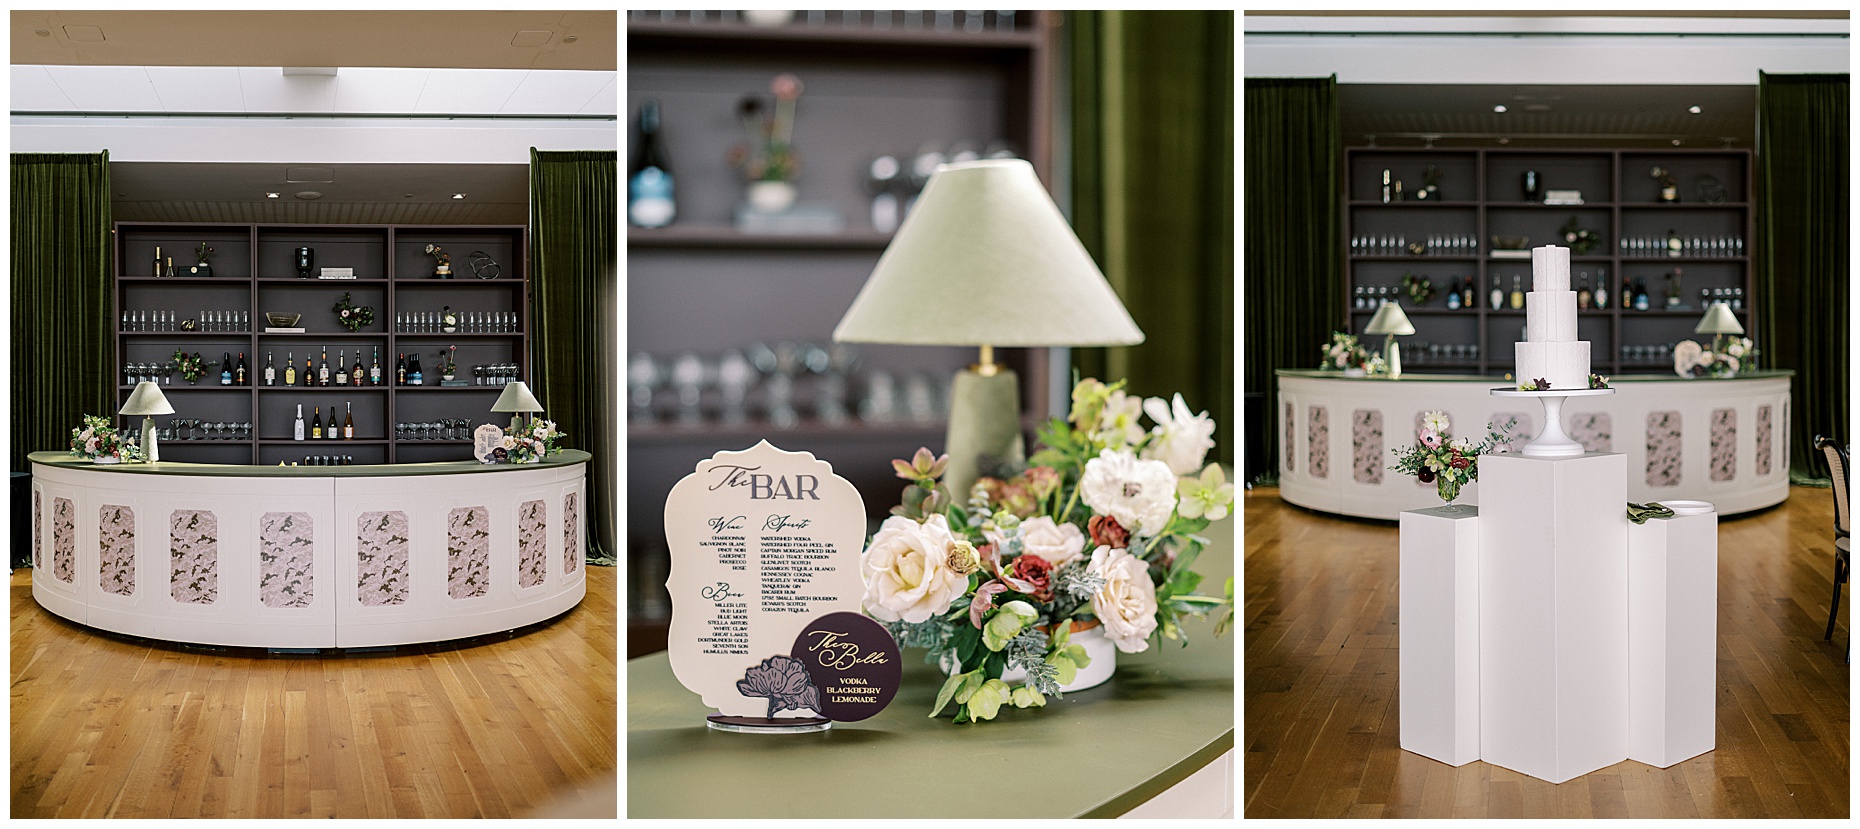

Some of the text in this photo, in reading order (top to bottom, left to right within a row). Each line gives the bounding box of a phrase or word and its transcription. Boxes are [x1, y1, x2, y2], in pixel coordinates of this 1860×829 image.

[708, 465, 820, 500] The BAR
[708, 516, 747, 534] Wine
[761, 514, 811, 532] Spirits
[701, 582, 745, 602] Beer
[808, 630, 848, 652] The
[827, 686, 881, 694] BLACKBERRY
